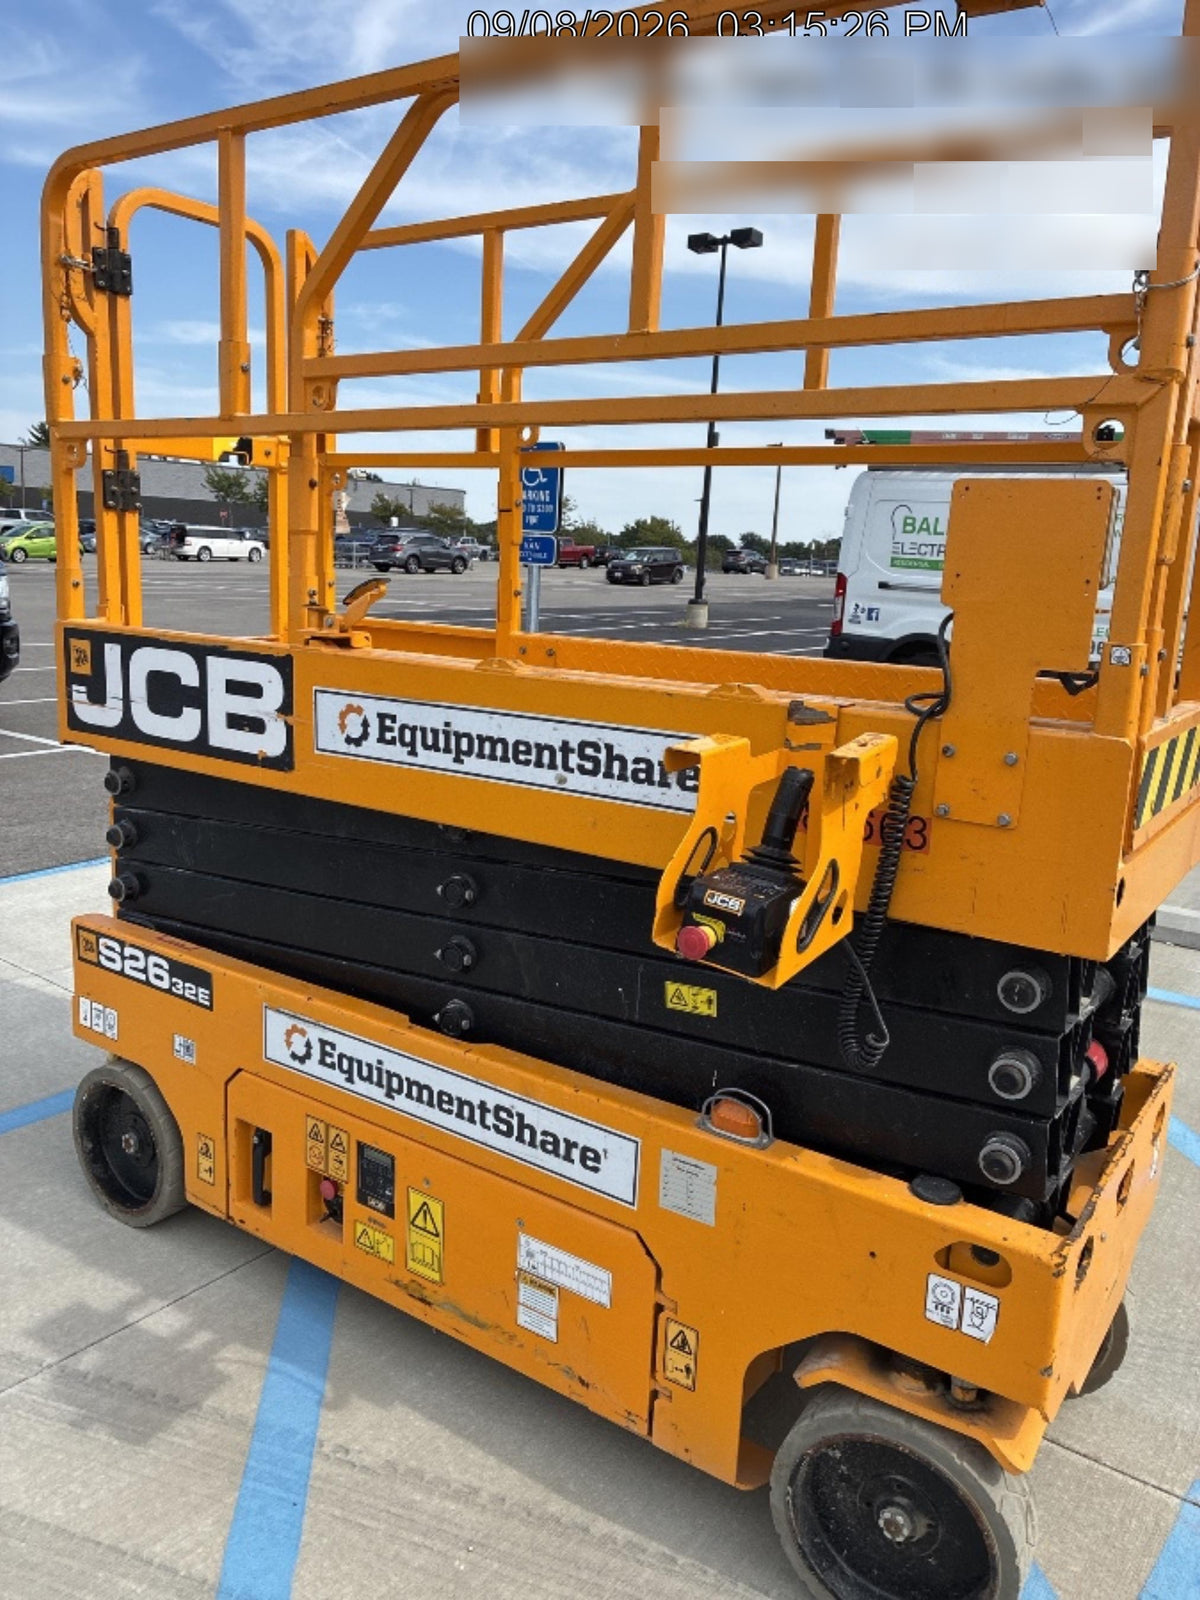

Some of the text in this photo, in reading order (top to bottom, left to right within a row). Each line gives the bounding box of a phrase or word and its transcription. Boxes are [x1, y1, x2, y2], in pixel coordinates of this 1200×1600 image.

[71, 642, 288, 758] JCB
[707, 893, 741, 911] JCB
[317, 1037, 602, 1174] EquipmentShare
